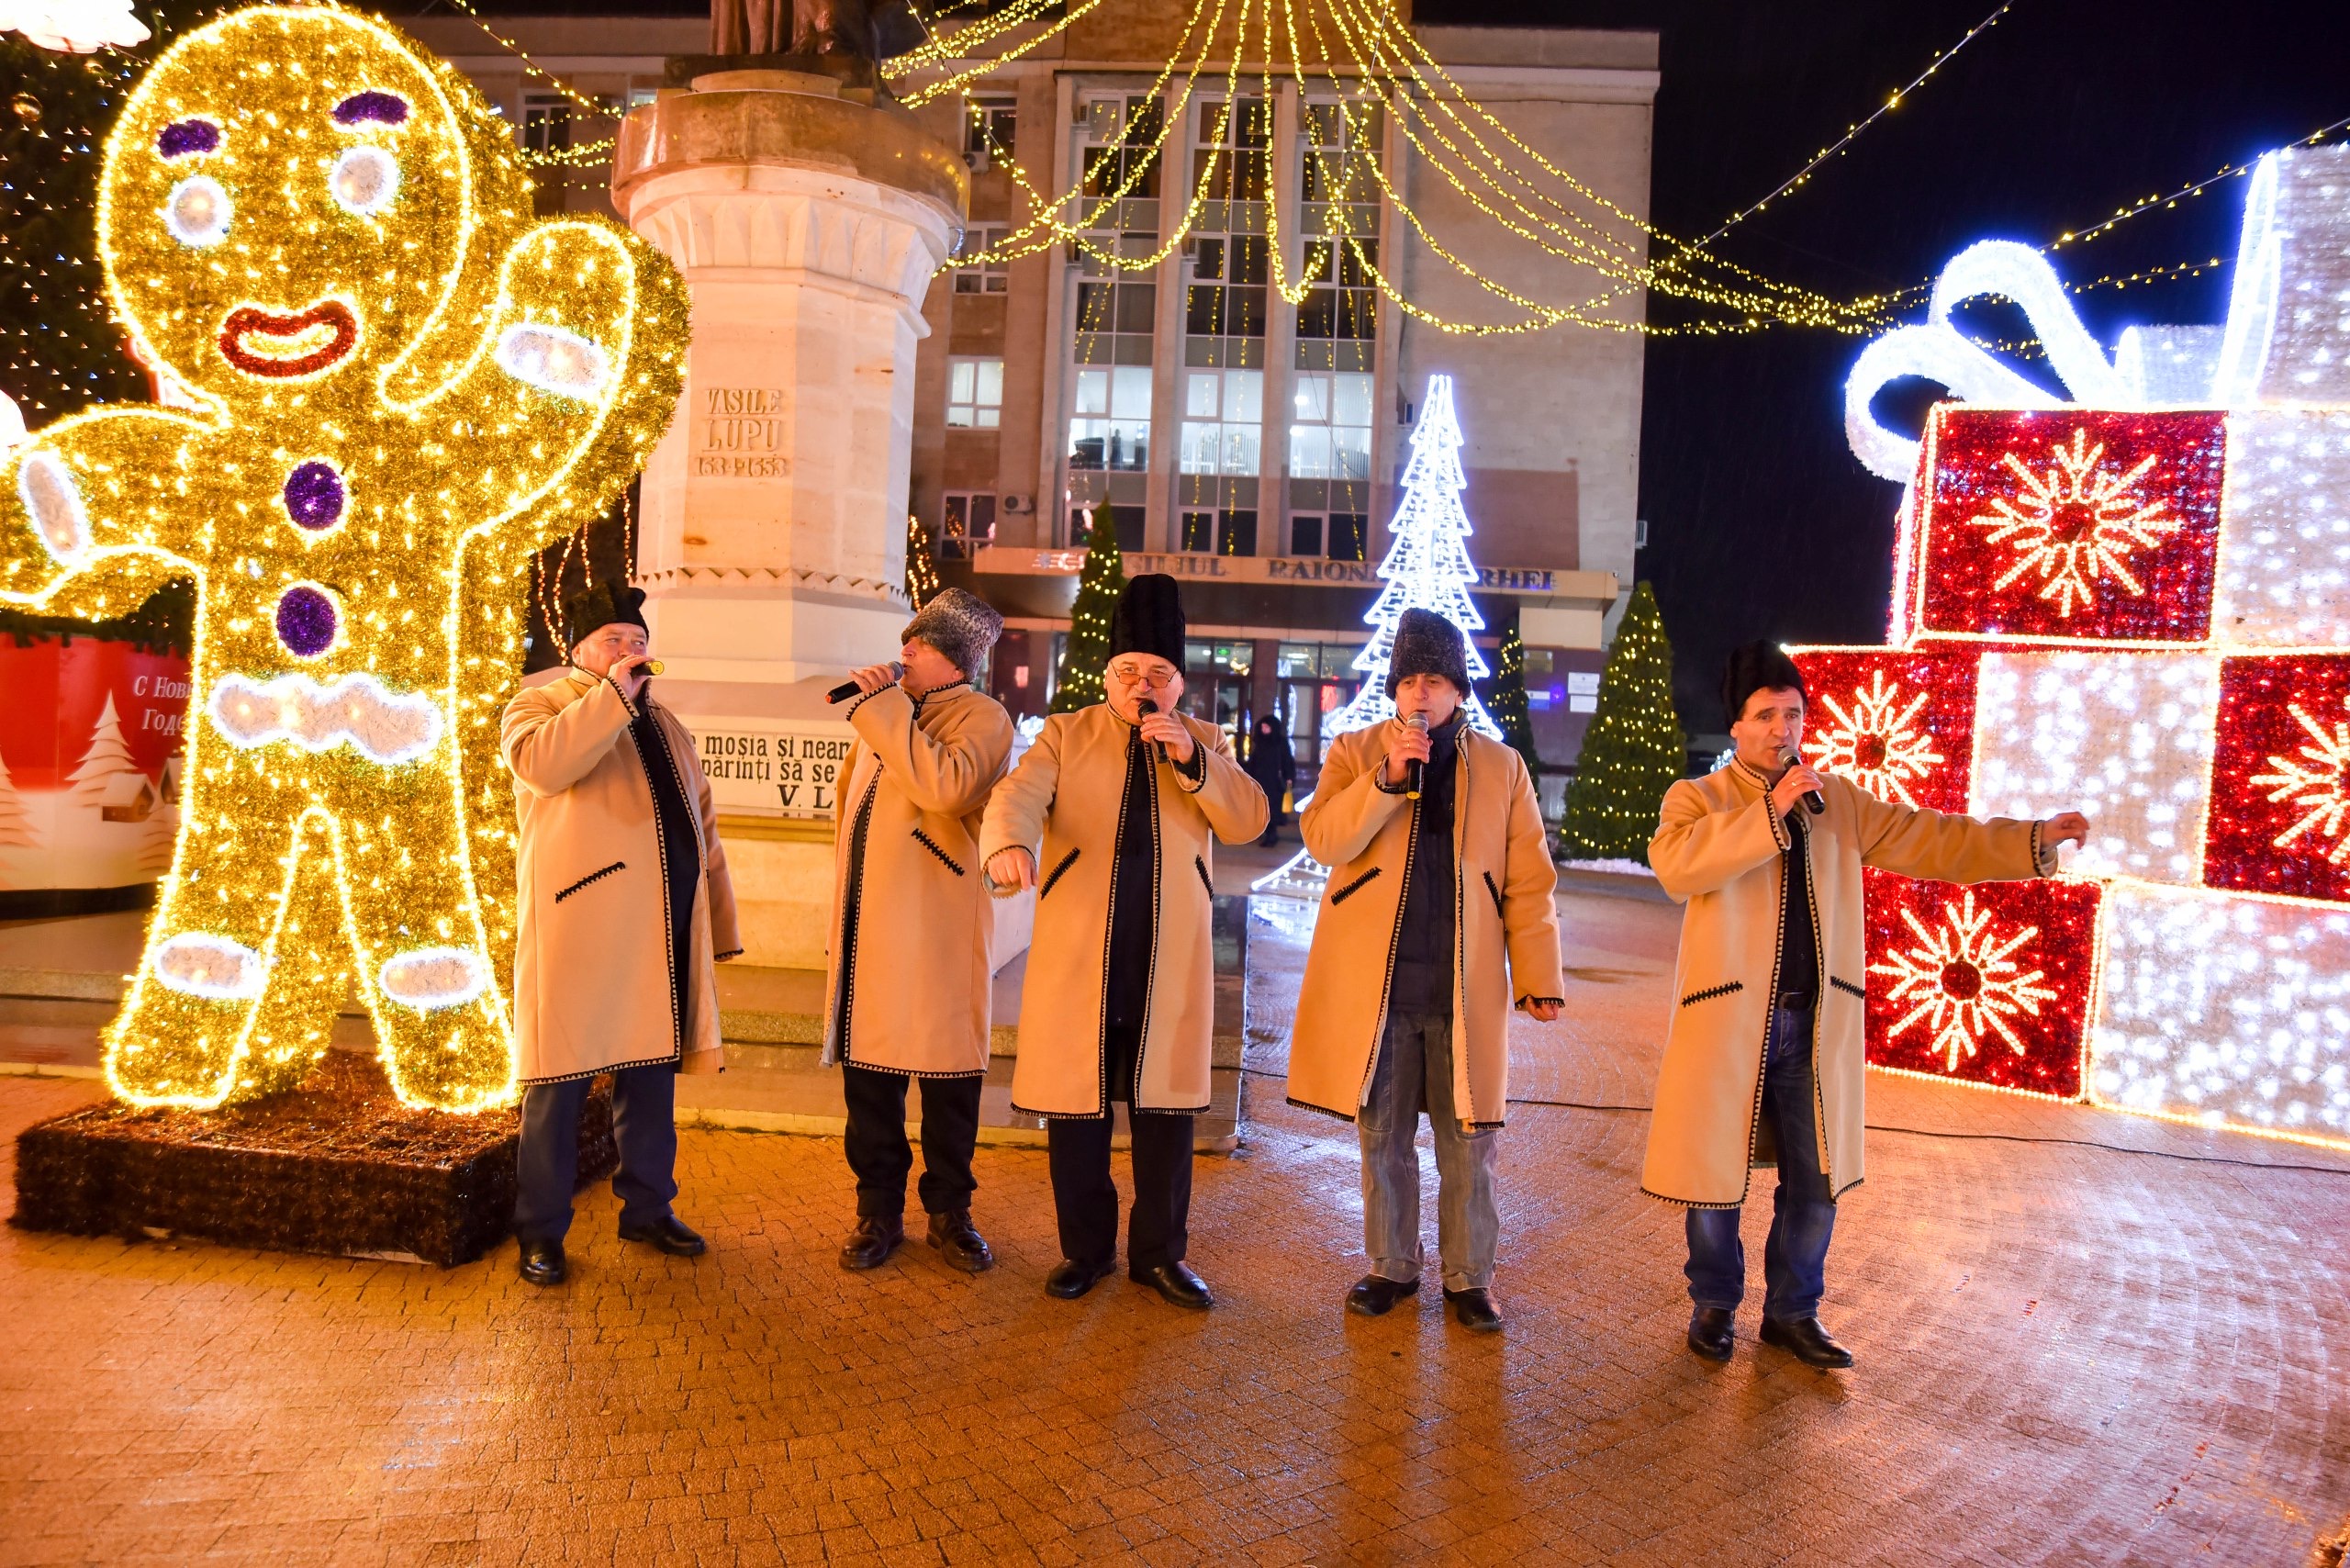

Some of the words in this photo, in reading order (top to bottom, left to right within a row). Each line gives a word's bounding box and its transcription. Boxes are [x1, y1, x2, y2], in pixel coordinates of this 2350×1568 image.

[704, 388, 780, 415] VASILE
[701, 419, 781, 453] LUPU
[1058, 553, 1231, 577] CSILIUL
[1474, 567, 1552, 590] RHEI
[134, 676, 148, 697] С
[779, 758, 803, 782] să
[811, 764, 835, 783] se
[777, 784, 801, 808] V.
[812, 786, 837, 809] L
